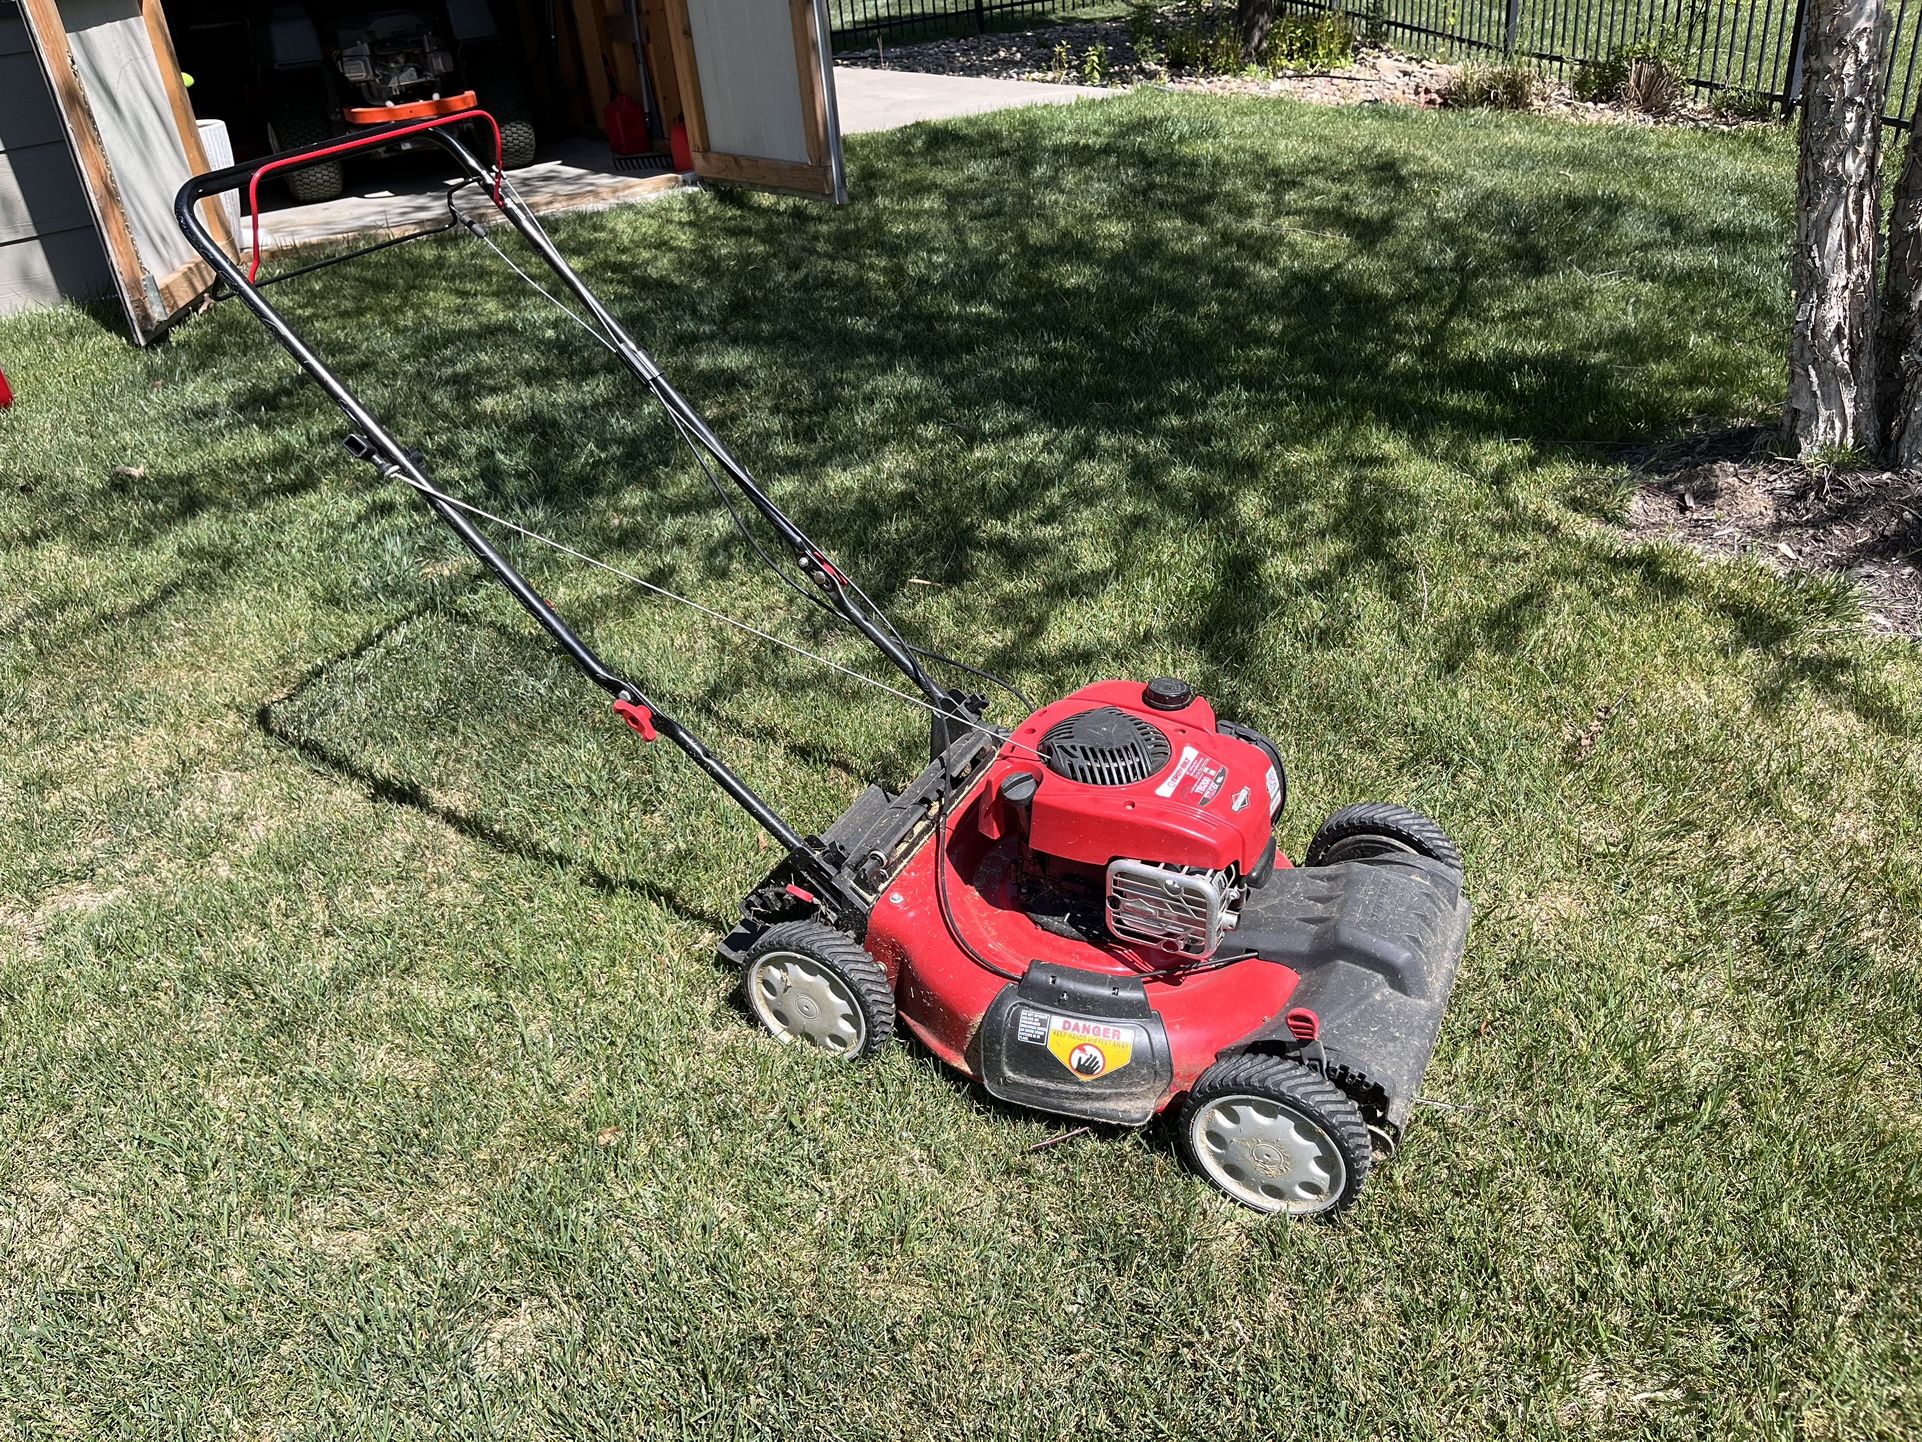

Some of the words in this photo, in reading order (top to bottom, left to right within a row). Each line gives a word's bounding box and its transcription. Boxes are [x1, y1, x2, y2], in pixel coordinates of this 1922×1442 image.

[1053, 1030, 1067, 1038] KEEP
[1068, 1033, 1087, 1042] HANDS
[1098, 1037, 1112, 1046] FEET
[1112, 1040, 1129, 1049] AWAY
[1061, 1019, 1121, 1040] DANGER
